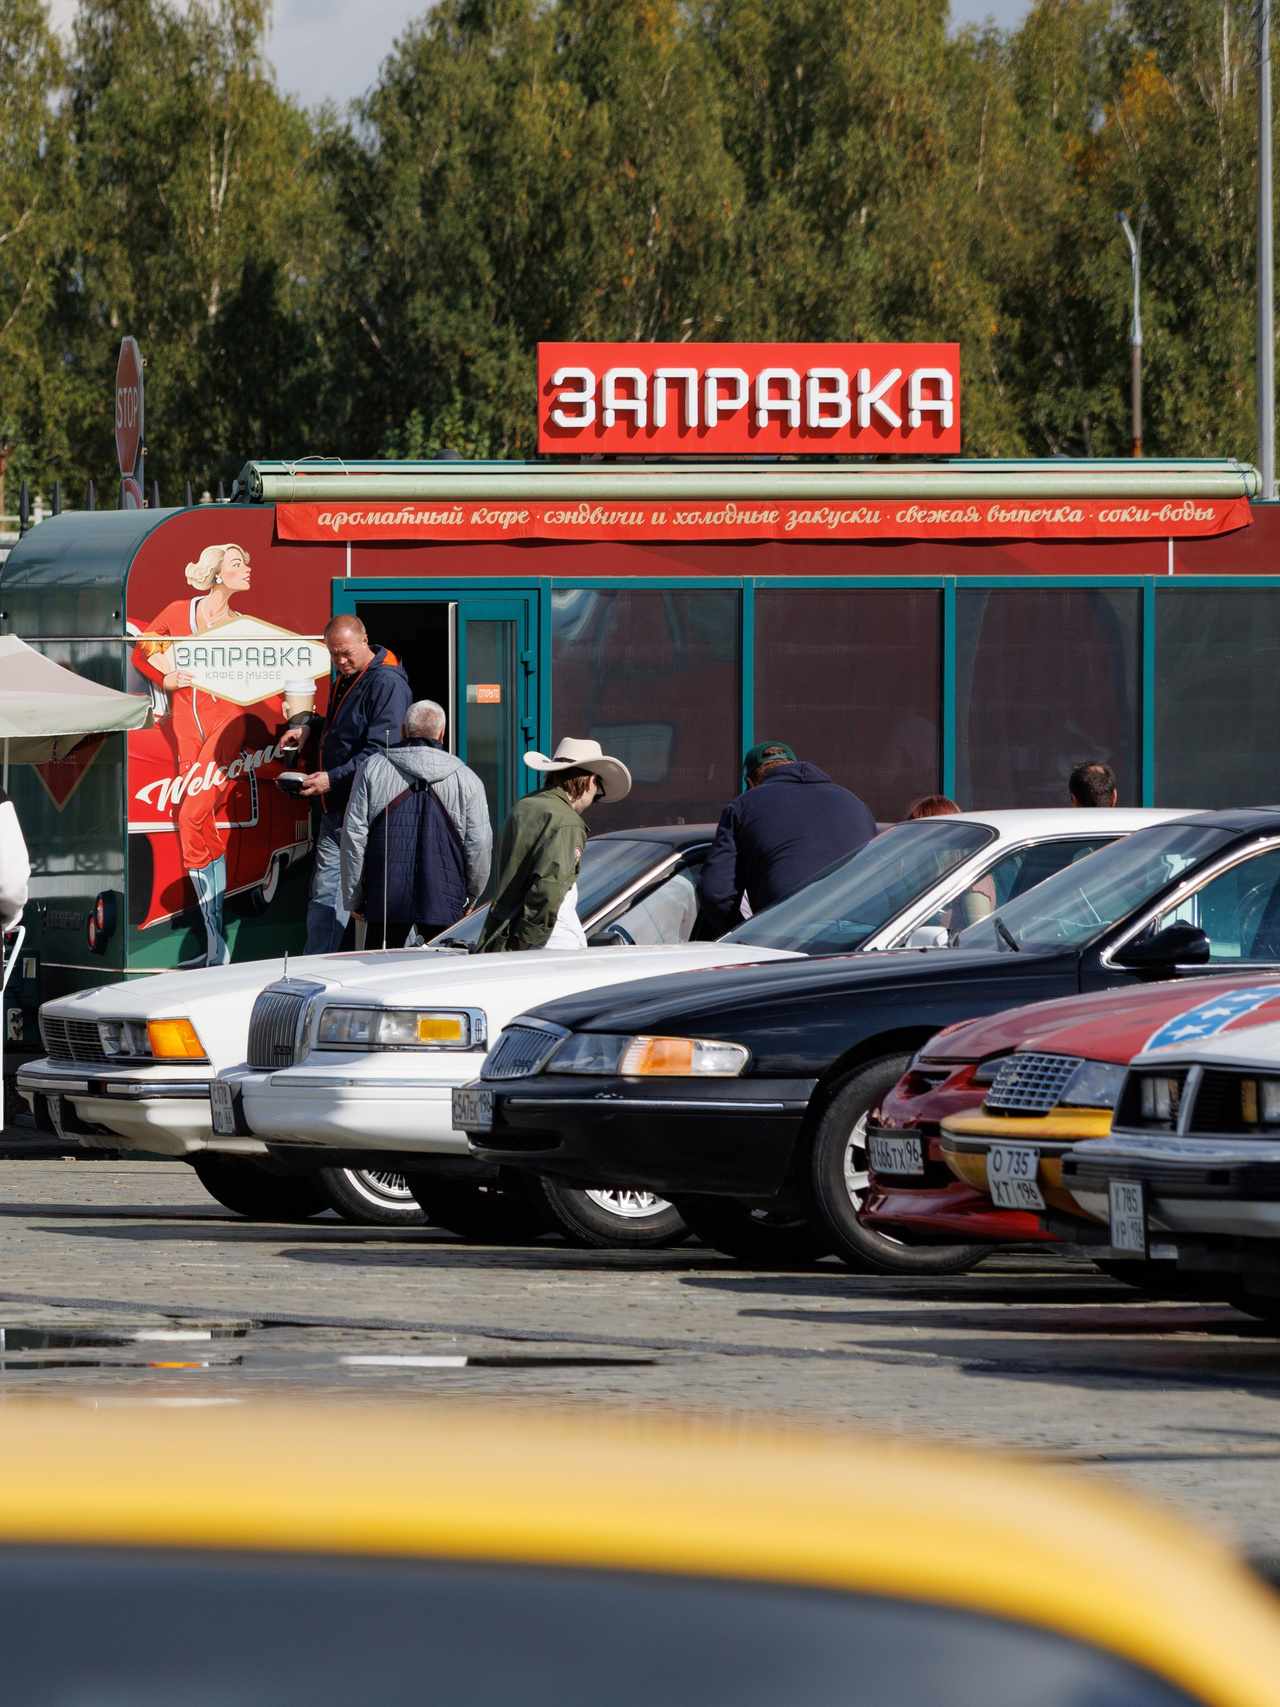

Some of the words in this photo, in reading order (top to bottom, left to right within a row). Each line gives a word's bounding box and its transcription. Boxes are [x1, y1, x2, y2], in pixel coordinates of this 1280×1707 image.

[117, 386, 138, 429] STOP
[551, 367, 954, 428] ЗАПРАВКА
[317, 506, 465, 533] ароматный
[543, 503, 645, 526] сэндвичи
[650, 508, 668, 525] и
[672, 503, 781, 526] холодные
[784, 506, 883, 531] закуски
[895, 505, 983, 524] свежая
[986, 504, 1085, 524] выпечка
[1098, 500, 1217, 523] соки-воды
[176, 646, 313, 668] ЗАПРАВКА
[205, 671, 235, 680] КАФЕ
[237, 671, 244, 680] В
[245, 671, 282, 680] МУЗЕЕ
[478, 688, 499, 699] ОТКРЫТО
[135, 743, 285, 812] Welcome
[906, 1140, 919, 1162] 96
[1006, 1151, 1030, 1176] 735
[992, 1180, 1011, 1208] ХТ
[1016, 1182, 1038, 1200] 196
